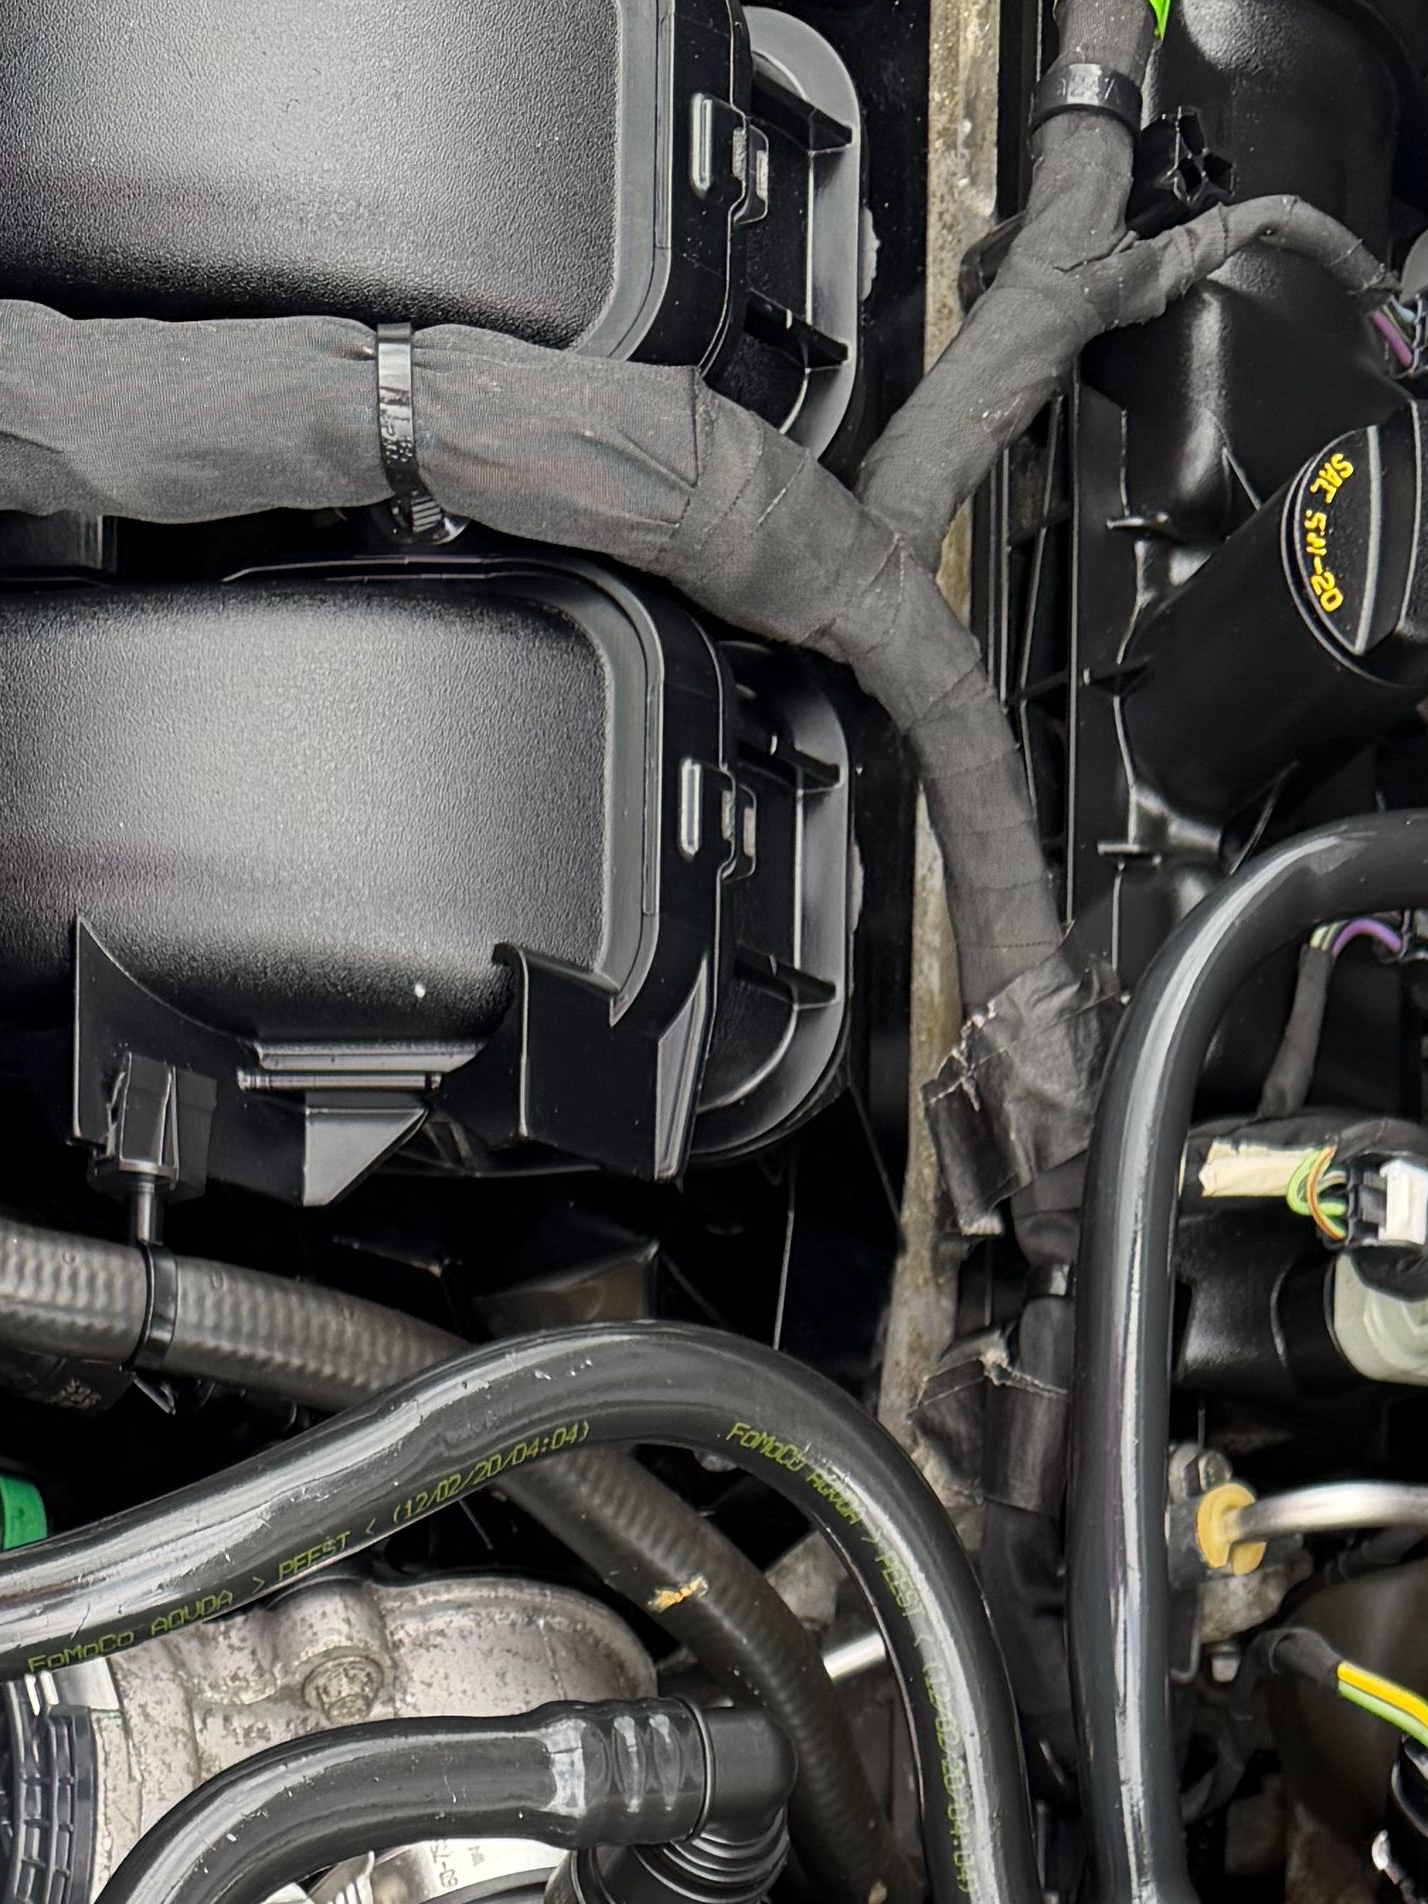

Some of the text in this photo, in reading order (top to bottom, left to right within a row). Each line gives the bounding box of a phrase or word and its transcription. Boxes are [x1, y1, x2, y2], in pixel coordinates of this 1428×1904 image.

[1309, 452, 1354, 503] SAE
[27, 1630, 135, 1672] FoMoCo
[392, 1420, 590, 1524] (12/02/20/04:04)
